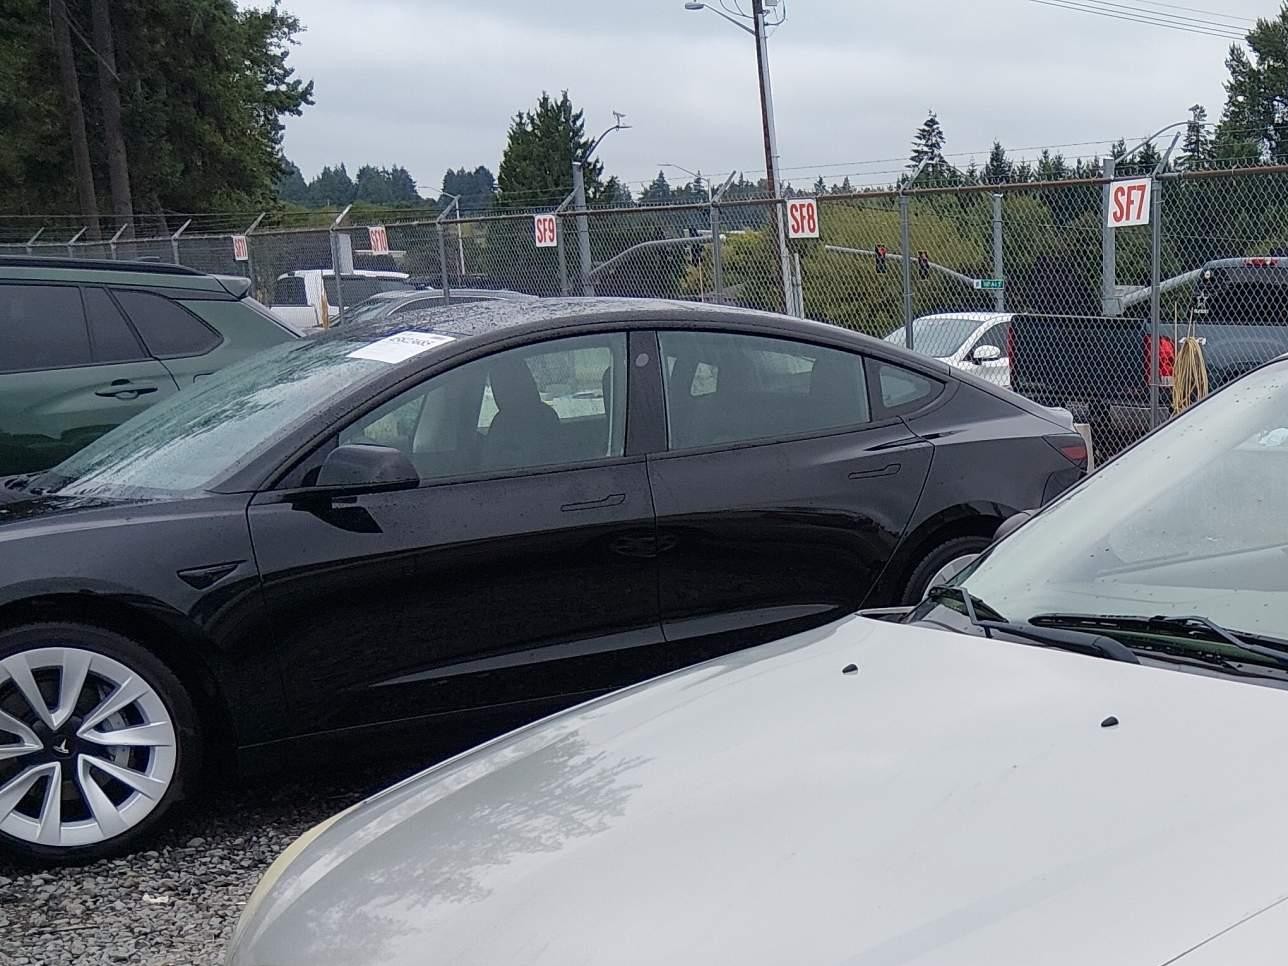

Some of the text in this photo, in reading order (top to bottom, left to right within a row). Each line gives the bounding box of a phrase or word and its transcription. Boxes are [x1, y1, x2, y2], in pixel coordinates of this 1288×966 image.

[790, 202, 817, 233] SF8
[1112, 184, 1147, 223] SF7
[370, 229, 388, 251] SF10
[536, 217, 555, 243] SF9
